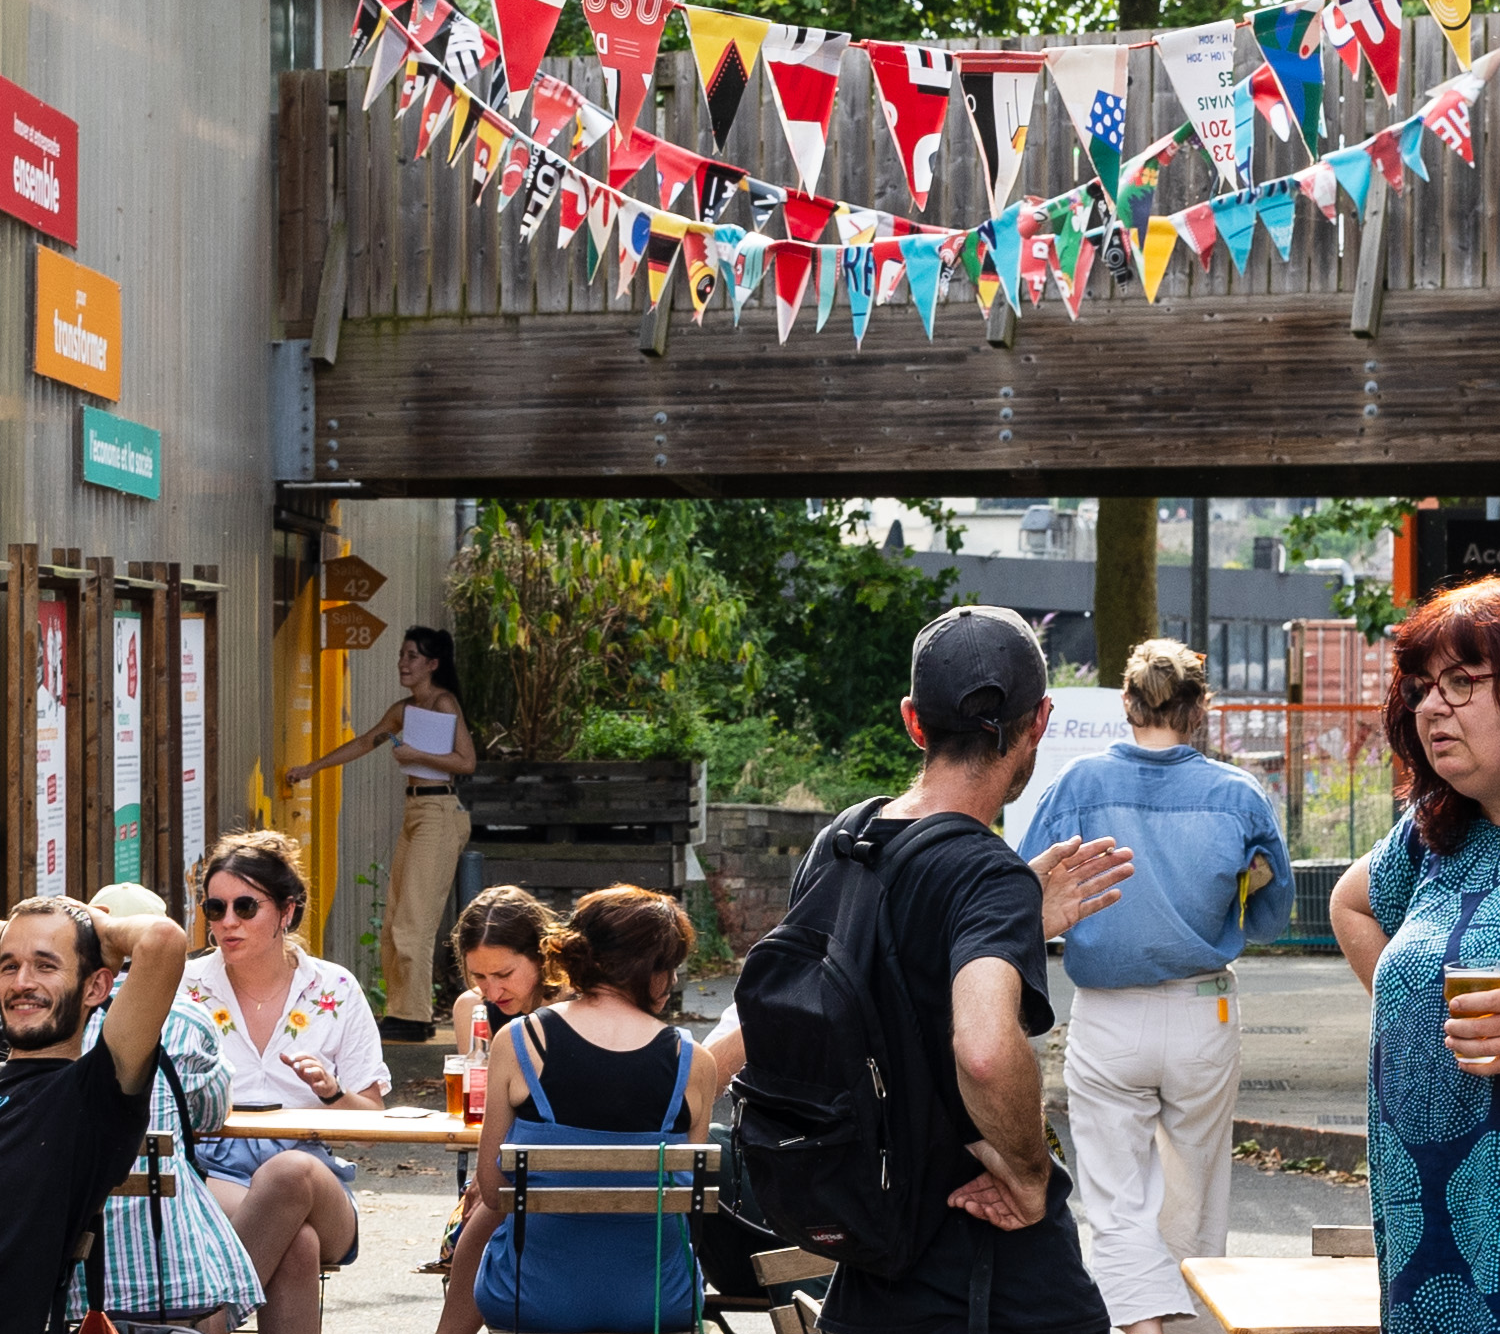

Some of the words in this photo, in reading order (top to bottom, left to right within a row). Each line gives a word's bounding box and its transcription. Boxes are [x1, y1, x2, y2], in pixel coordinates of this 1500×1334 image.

[13, 154, 60, 214] ensemble
[76, 289, 87, 310] pour
[54, 309, 107, 372] transformer
[89, 428, 119, 469] l'économie
[343, 579, 369, 597] 42
[332, 612, 363, 625] Salle
[345, 626, 371, 645] 28
[1043, 723, 1058, 738] E
[1064, 719, 1129, 739] RELAIS
